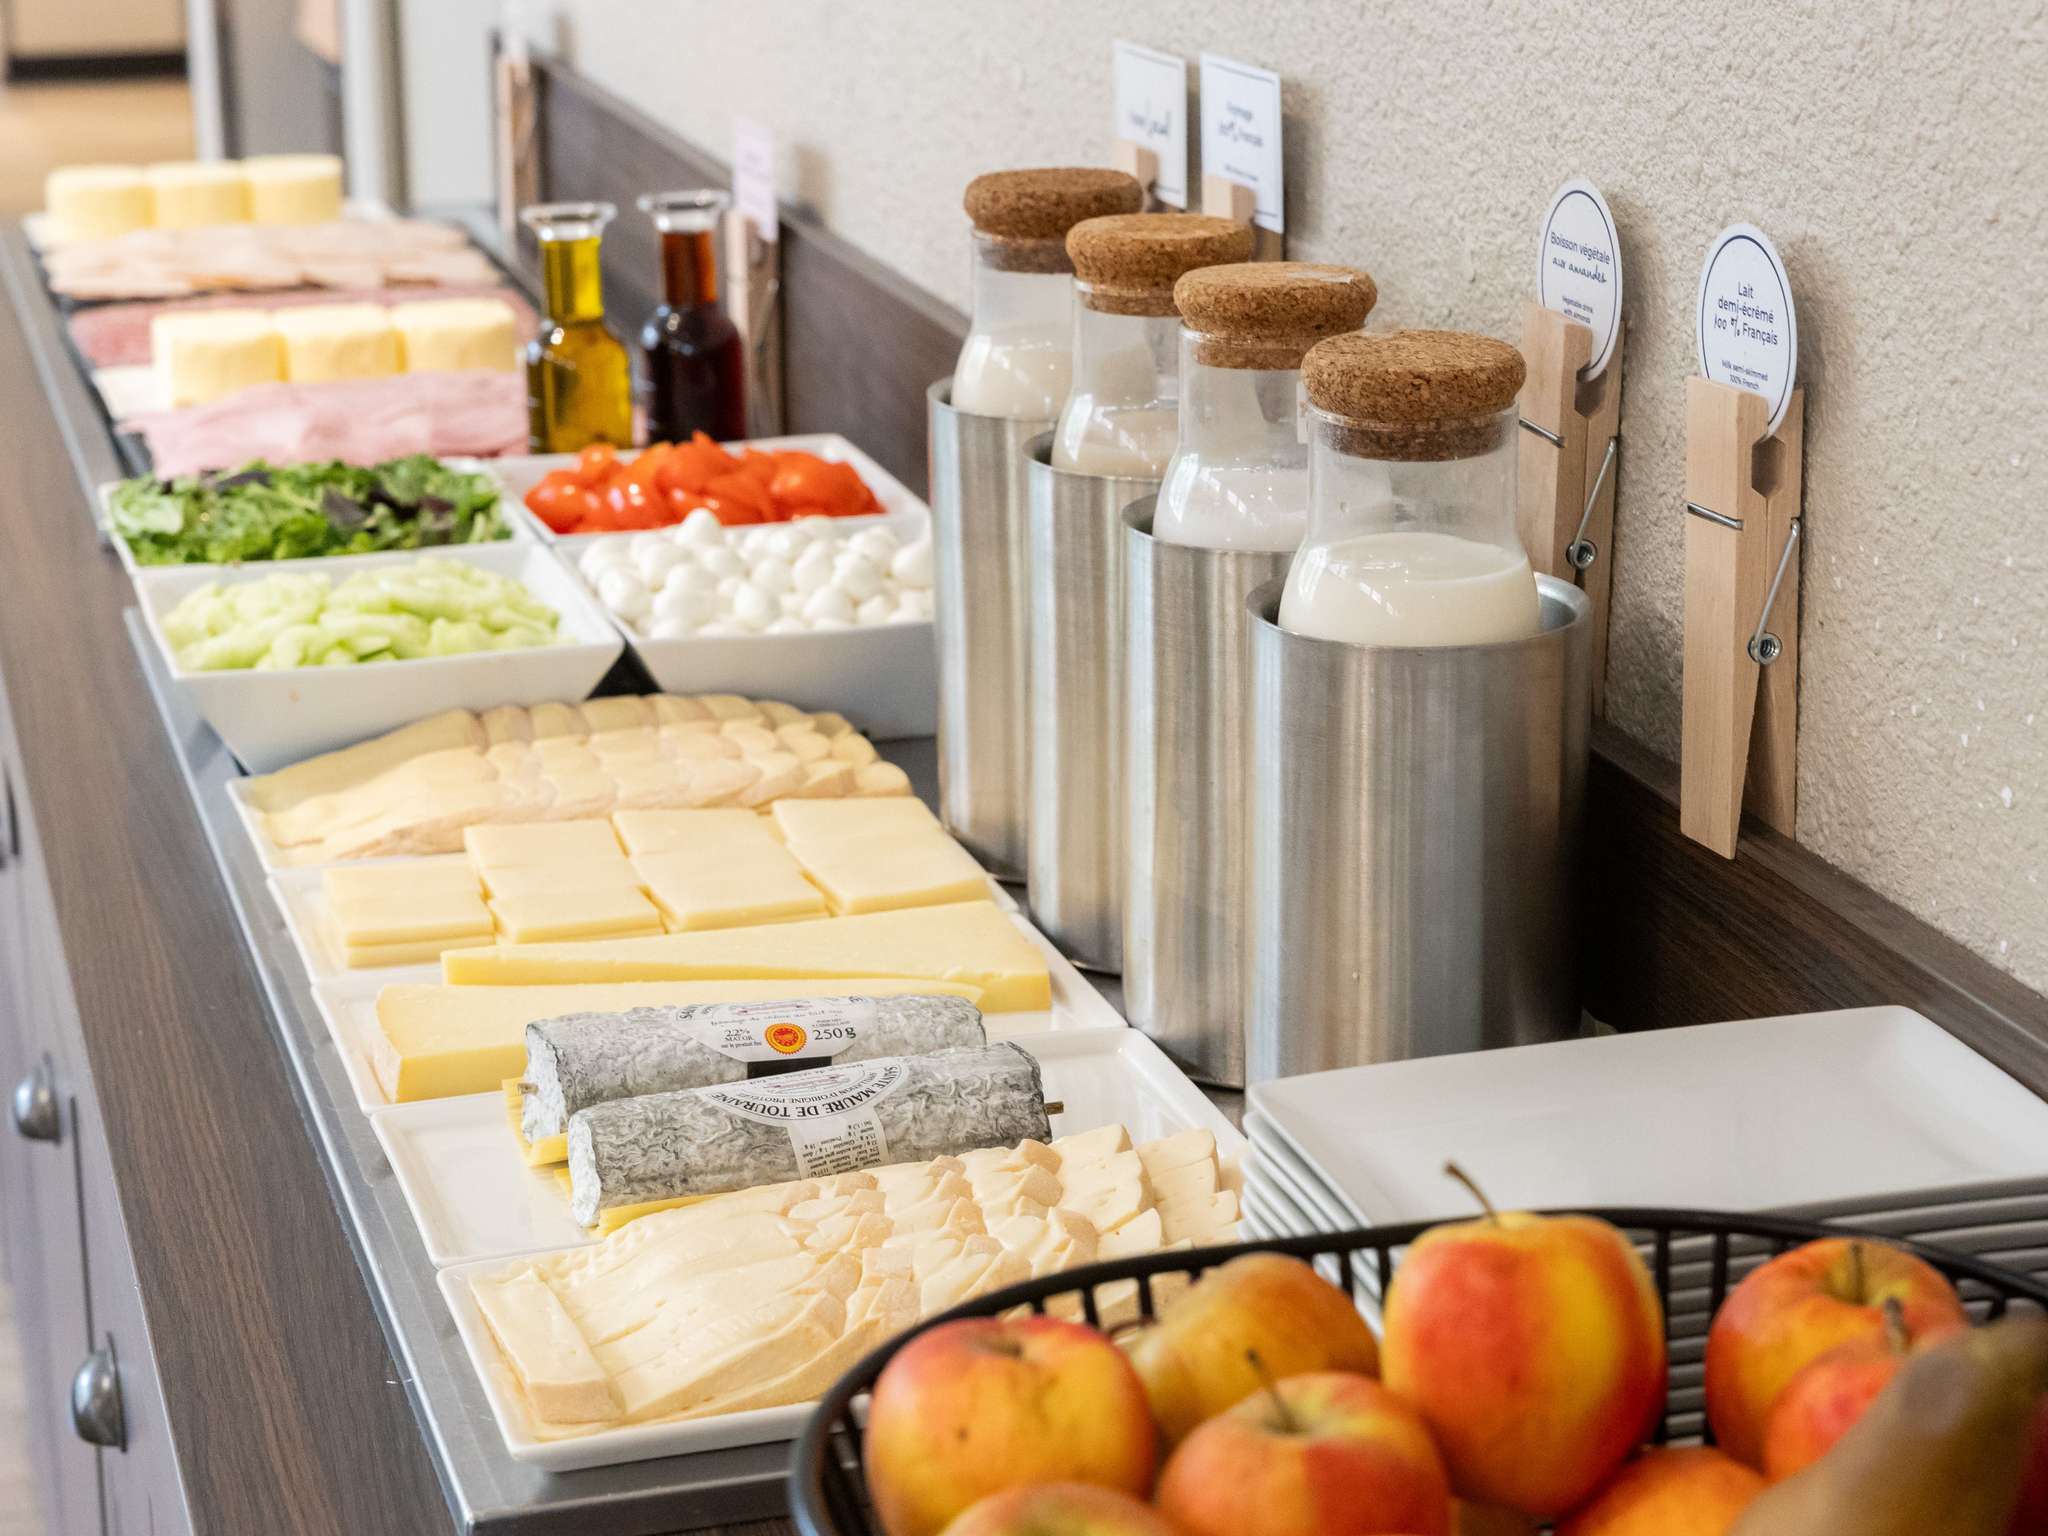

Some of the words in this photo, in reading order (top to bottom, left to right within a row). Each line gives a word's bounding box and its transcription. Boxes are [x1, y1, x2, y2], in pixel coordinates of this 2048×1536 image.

[1551, 231, 1577, 251] Boisson
[1580, 243, 1610, 264] végétale
[1553, 257, 1566, 269] aux
[1569, 263, 1607, 283] amandes
[1737, 281, 1754, 298] Lait
[1718, 296, 1774, 323] demi-écrémé
[1742, 323, 1778, 345] Français
[813, 1028, 843, 1041] 250
[845, 1027, 857, 1039] g
[711, 1092, 791, 1118] TOURAINE
[795, 1105, 818, 1118] DE
[822, 1088, 876, 1114] MAURE
